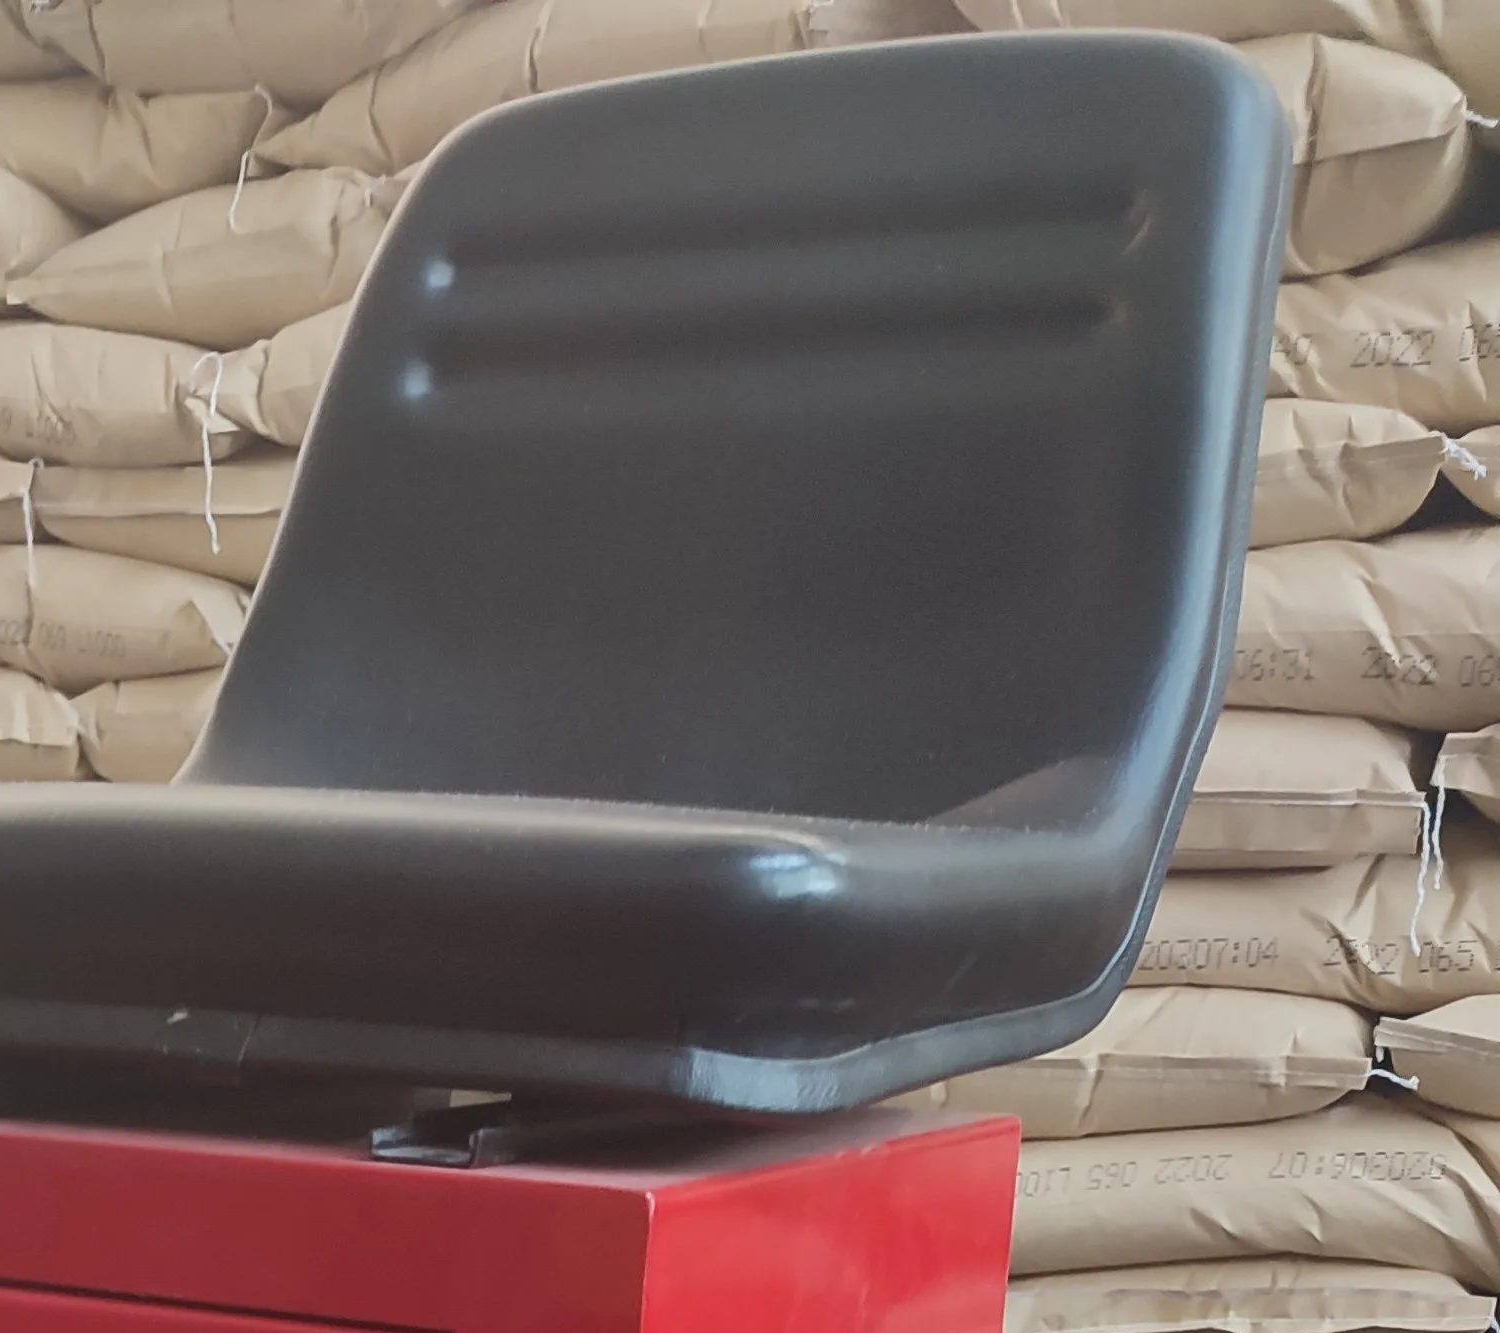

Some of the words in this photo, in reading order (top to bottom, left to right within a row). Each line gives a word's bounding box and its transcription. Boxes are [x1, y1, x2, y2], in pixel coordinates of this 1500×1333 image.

[1350, 329, 1436, 368] 2022
[1361, 645, 1439, 687] 2022
[1460, 653, 1500, 688] 06
[1418, 939, 1480, 974] 065
[1085, 1160, 1138, 1192] 065
[1154, 1153, 1234, 1186] 2022
